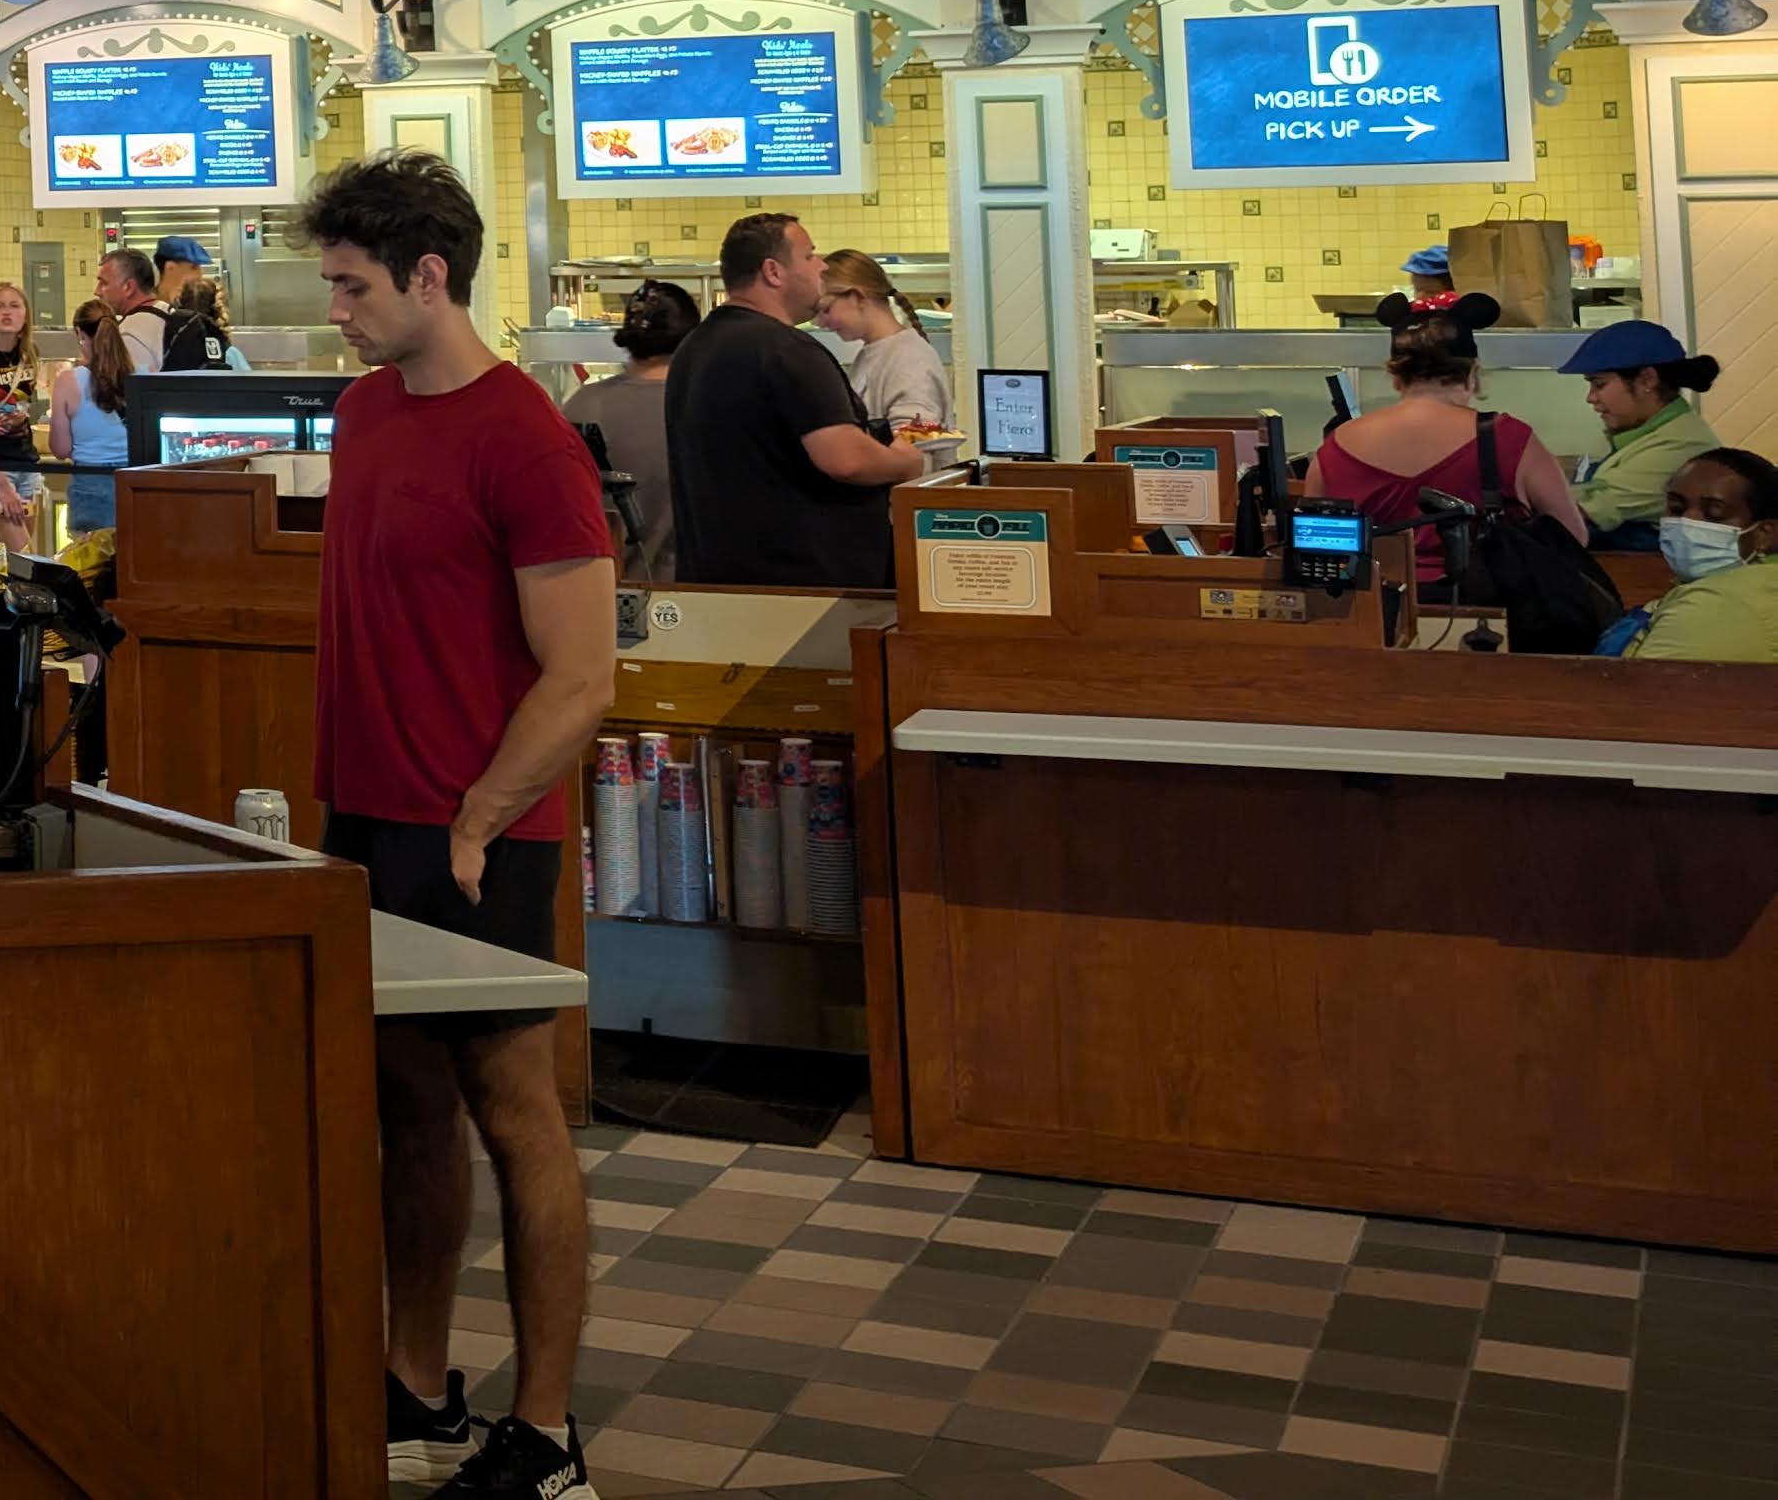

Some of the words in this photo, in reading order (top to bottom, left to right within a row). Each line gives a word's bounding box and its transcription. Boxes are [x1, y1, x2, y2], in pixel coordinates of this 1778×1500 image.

[1254, 88, 1350, 110] MOBILE
[1356, 85, 1441, 106] ORDER
[1265, 120, 1324, 141] PICK
[1330, 119, 1359, 139] UP
[282, 395, 324, 406] True
[995, 397, 1034, 414] Enter
[998, 420, 1034, 435] Here
[654, 612, 678, 623] YES
[536, 1461, 577, 1500] HOKA
